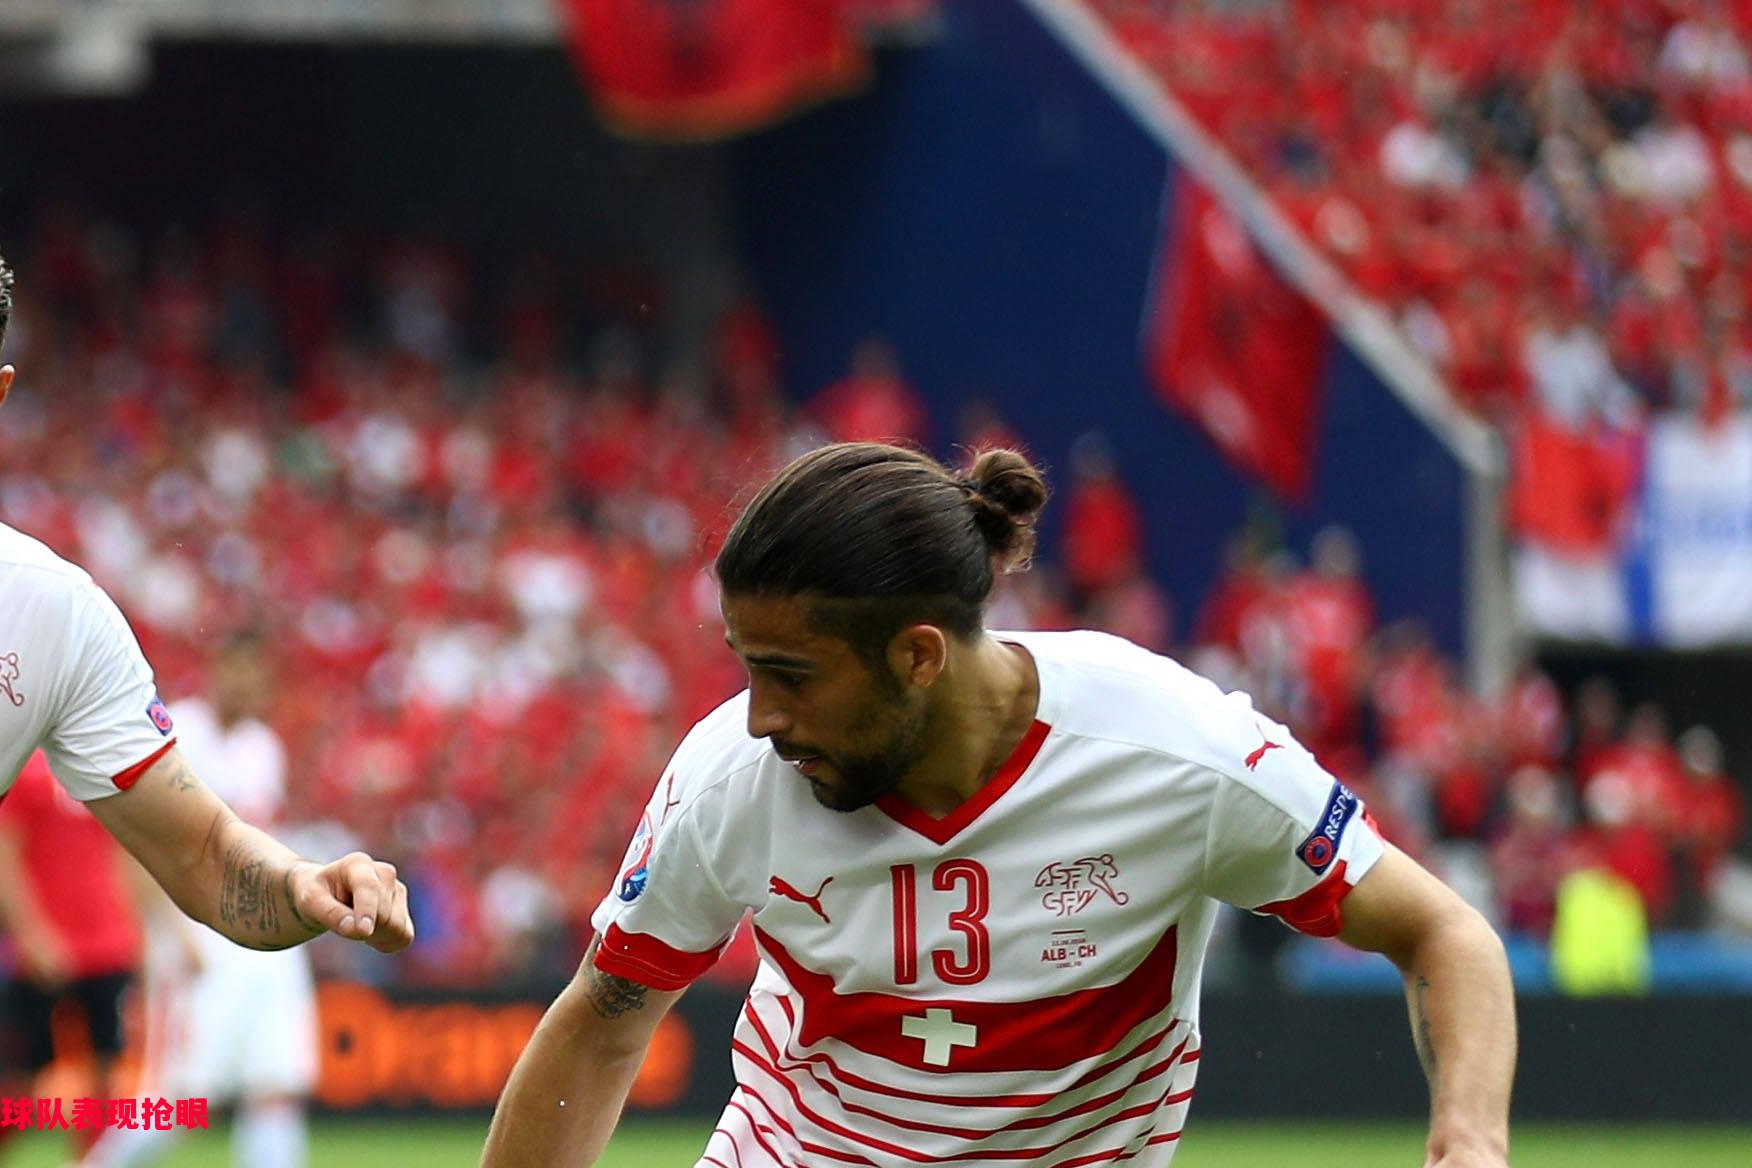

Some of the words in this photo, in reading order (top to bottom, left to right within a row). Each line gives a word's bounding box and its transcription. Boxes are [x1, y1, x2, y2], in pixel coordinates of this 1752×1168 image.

[890, 858, 990, 986] 13
[1041, 948, 1066, 962] ALB
[1078, 945, 1097, 958] CH
